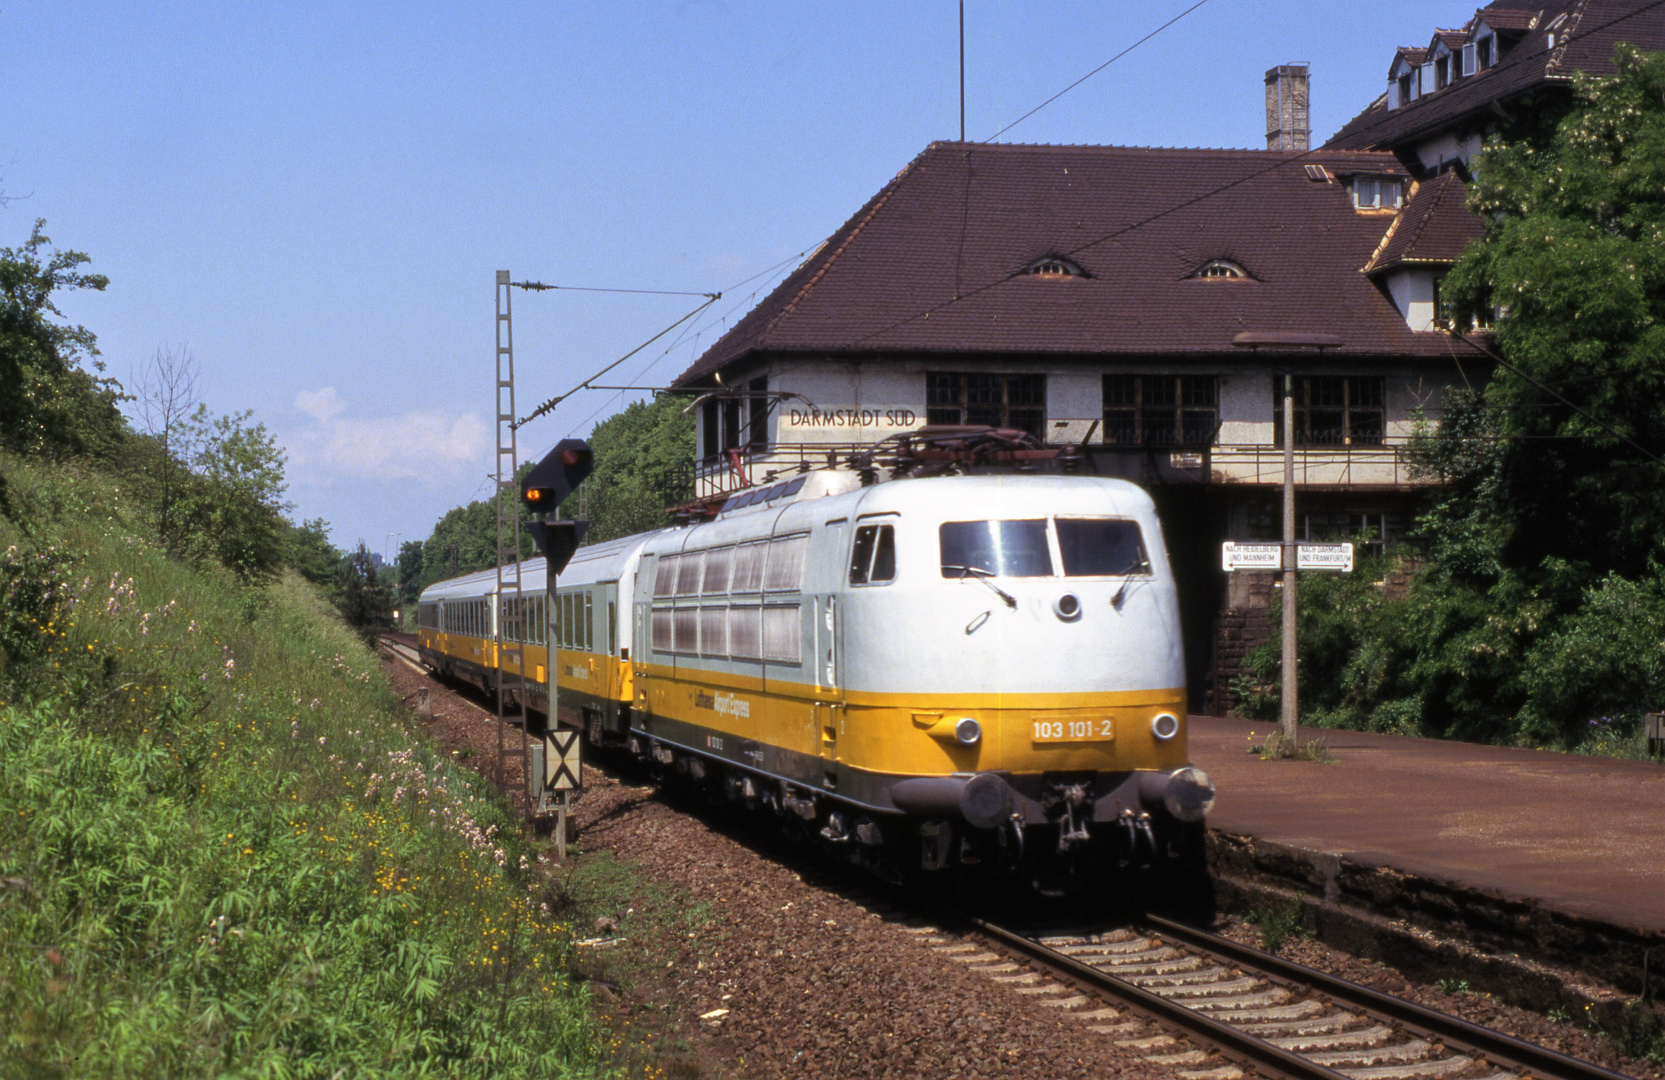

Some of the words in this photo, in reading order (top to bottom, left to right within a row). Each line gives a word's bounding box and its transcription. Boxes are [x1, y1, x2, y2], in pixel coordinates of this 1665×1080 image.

[791, 409, 881, 427] DARMSTADT
[886, 409, 916, 427] SÜD
[1242, 545, 1279, 553] HEIDELBERG
[1301, 545, 1316, 553] NACH
[1318, 545, 1349, 553] DARMSTADT
[1243, 554, 1275, 562] MANNHEIM
[1300, 554, 1311, 562] UND
[1312, 554, 1351, 562] FRANKFURT/M
[714, 690, 730, 717] Airport
[730, 692, 750, 720] Express
[1033, 721, 1063, 738] 103
[1068, 720, 1112, 737] 101-2
